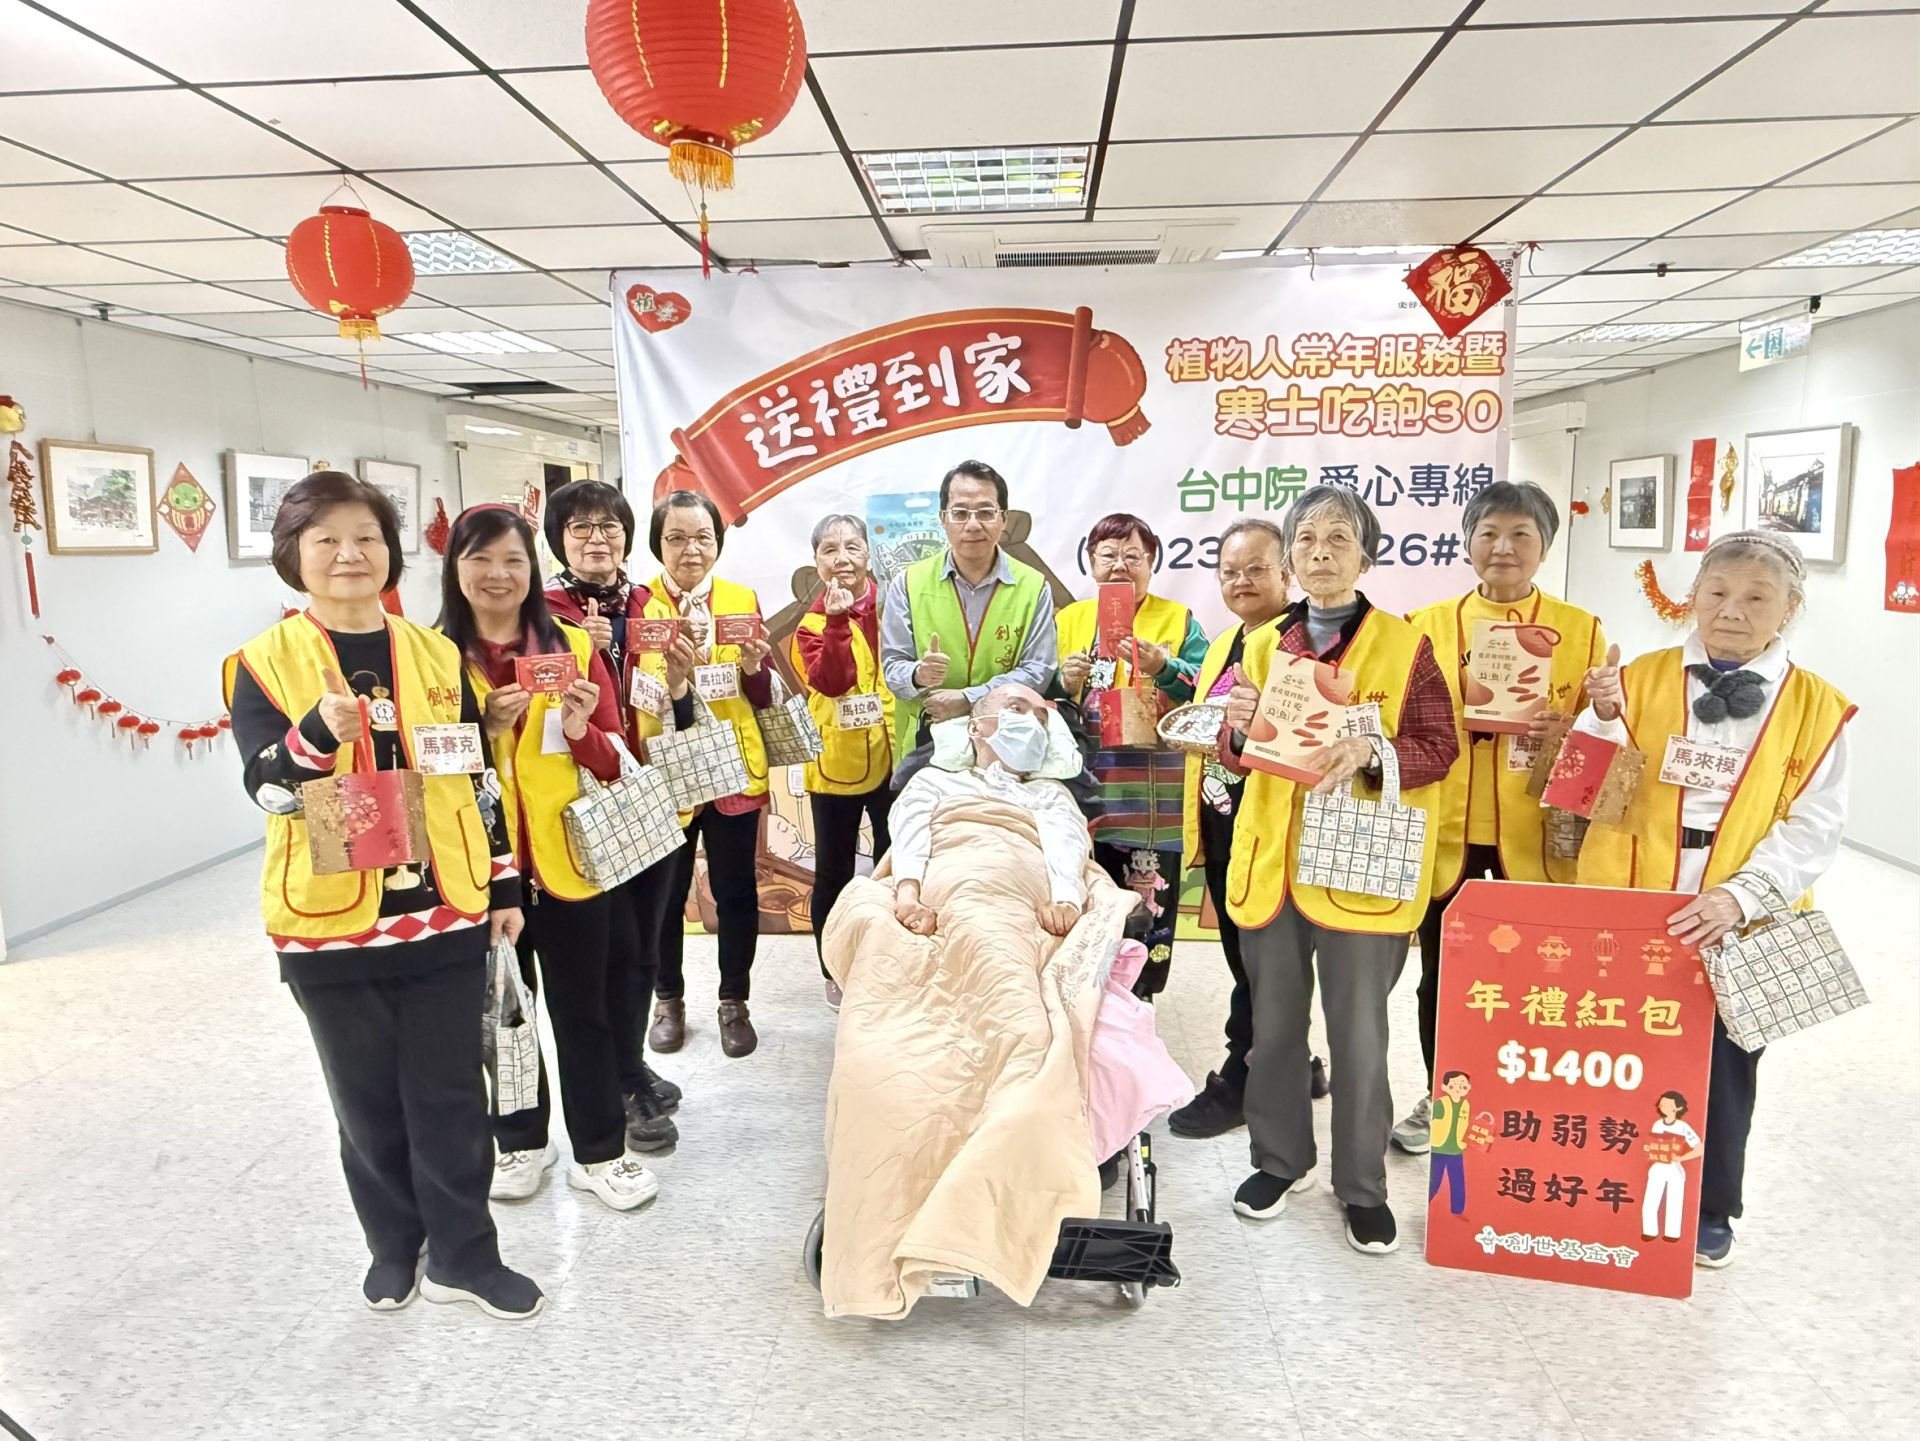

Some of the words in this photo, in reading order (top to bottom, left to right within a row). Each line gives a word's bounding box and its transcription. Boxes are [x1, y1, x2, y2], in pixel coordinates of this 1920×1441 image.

[1425, 251, 1484, 316] 福
[1165, 331, 1507, 383] 植物人常年服務暨
[741, 332, 1031, 469] 送禮到家
[1215, 383, 1503, 440] 寒士吃飽30
[1177, 464, 1308, 512] 台中院
[423, 735, 476, 755] 馬賽克
[1336, 715, 1376, 738] 卡龍
[1671, 747, 1737, 775] 馬來模
[1465, 979, 1684, 1036] 年禮紅包
[1497, 1040, 1644, 1091] $1400
[1500, 1110, 1640, 1155] 助弱勢
[1497, 1168, 1635, 1213] 過好年
[1504, 1231, 1639, 1268] 創世基金會
